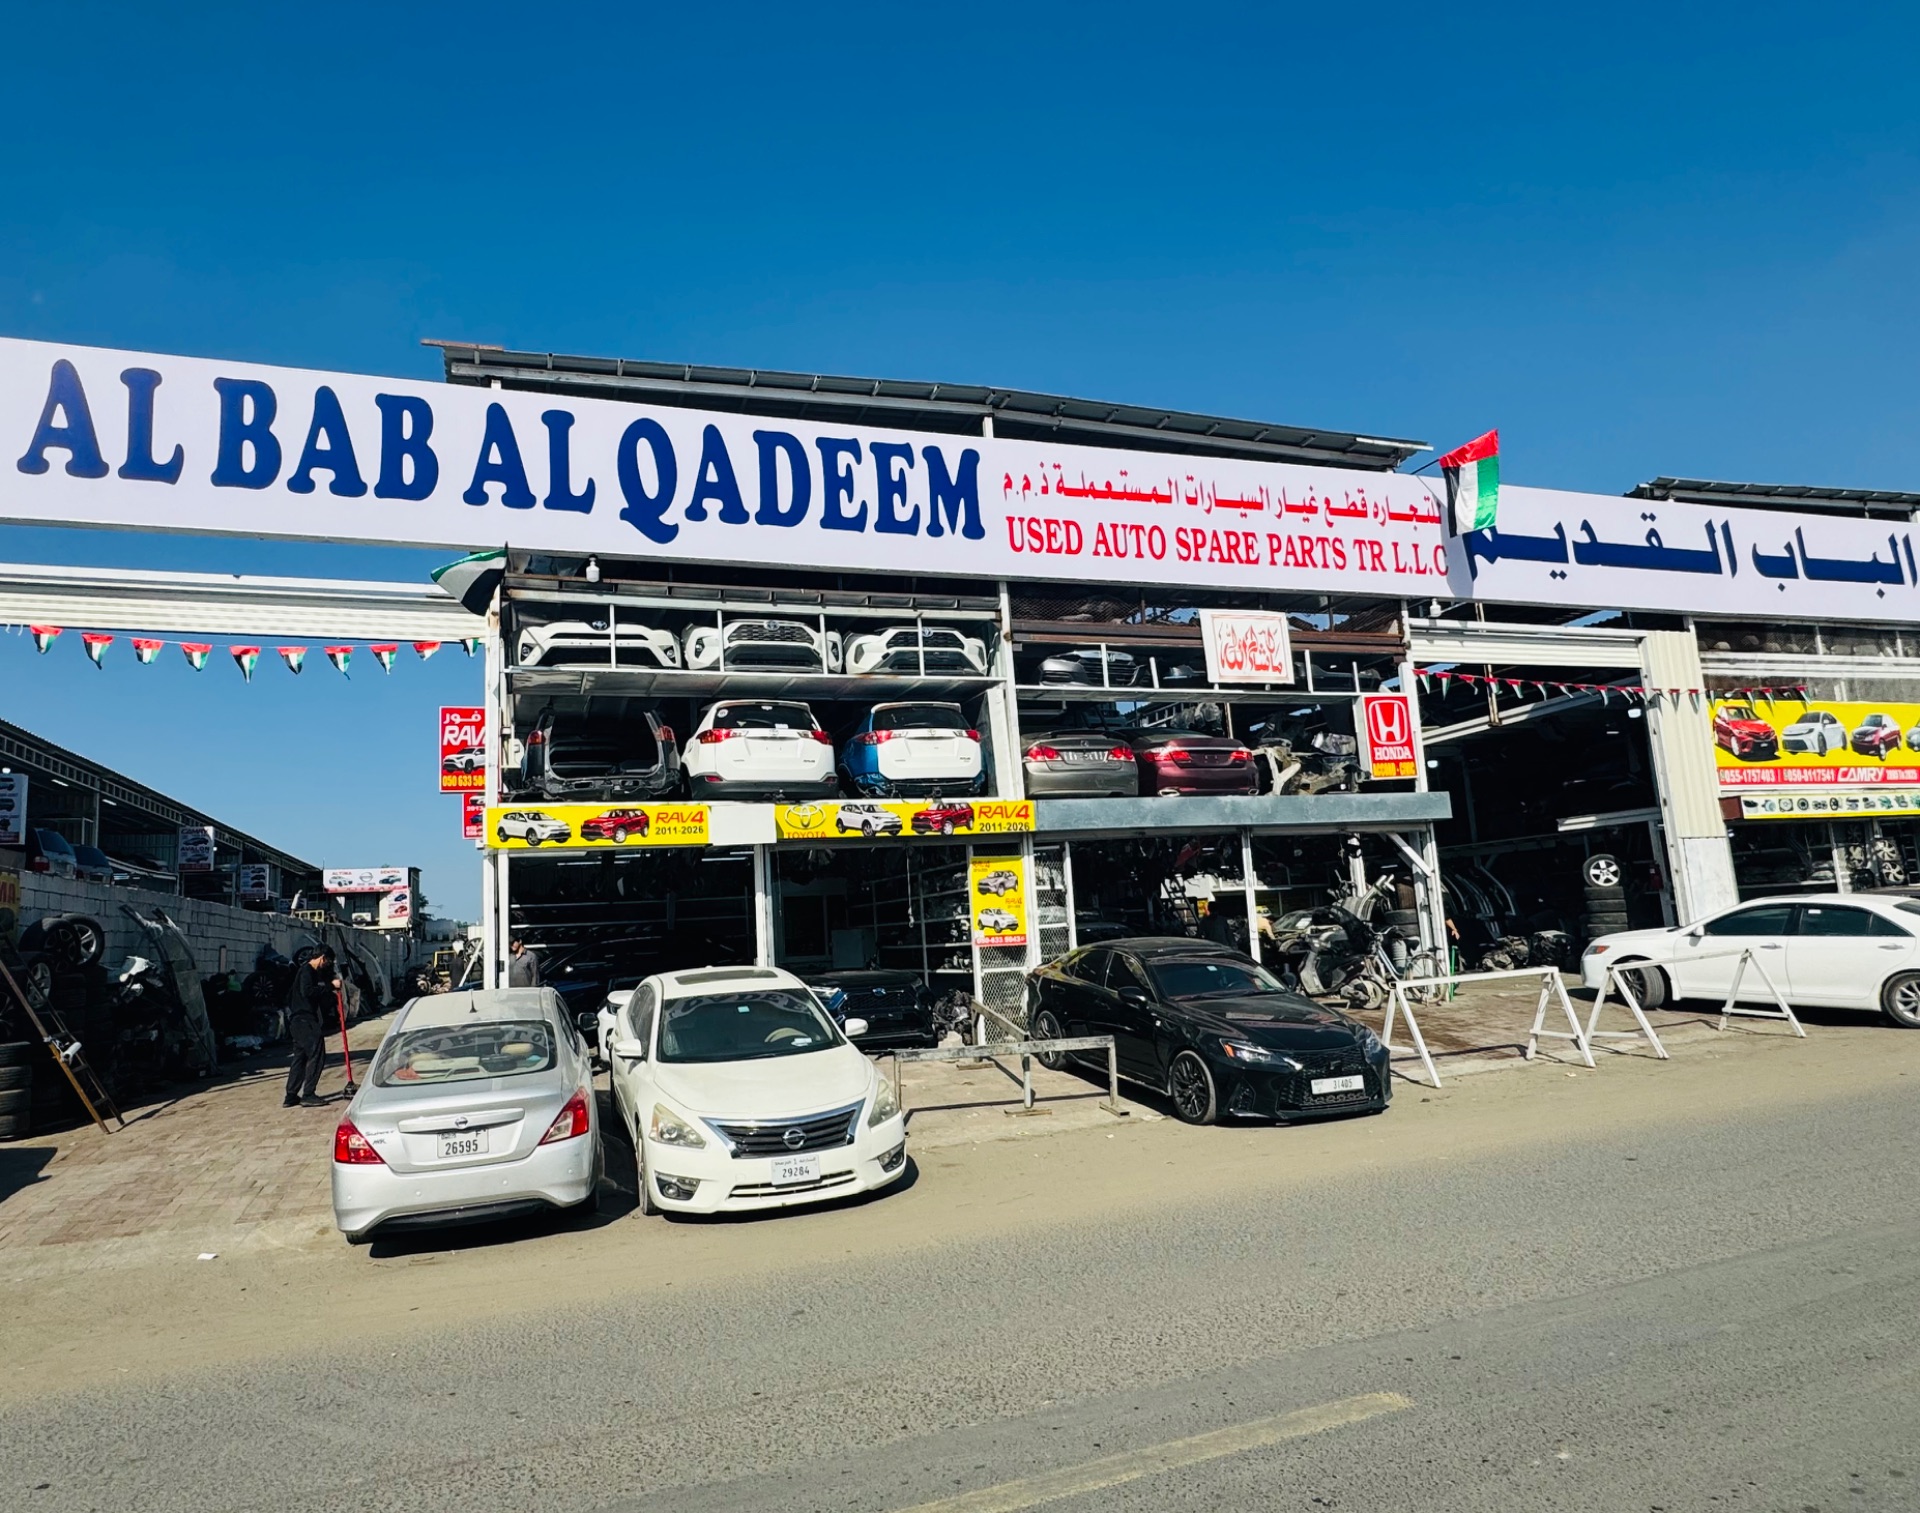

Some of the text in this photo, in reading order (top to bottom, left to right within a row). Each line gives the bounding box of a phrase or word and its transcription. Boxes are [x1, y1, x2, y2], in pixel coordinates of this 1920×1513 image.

[16, 358, 986, 544] AL BAB AL QADEEM
[1055, 462, 1179, 504] المستعملة
[1185, 474, 1271, 518] السيارات
[1274, 485, 1319, 523] غيار
[1324, 488, 1368, 528] قطع
[1005, 515, 1083, 555] USED
[1092, 522, 1167, 560] AUTO
[1175, 526, 1260, 565] SPARE
[1266, 532, 1347, 570] PARTS
[1353, 538, 1387, 572] TR
[1751, 524, 1918, 598] الباب
[442, 725, 485, 746] RAV
[1373, 746, 1414, 760] HONDA
[442, 775, 457, 787] 050
[458, 775, 472, 787] 633
[1837, 767, 1885, 782] CAMRY
[656, 811, 704, 824] RAV4
[978, 805, 1030, 819] RAV4
[655, 825, 704, 836] 2011-2026
[979, 822, 1030, 832] 2011-2026
[445, 1139, 478, 1155] 26595
[782, 1166, 810, 1178] 29284
